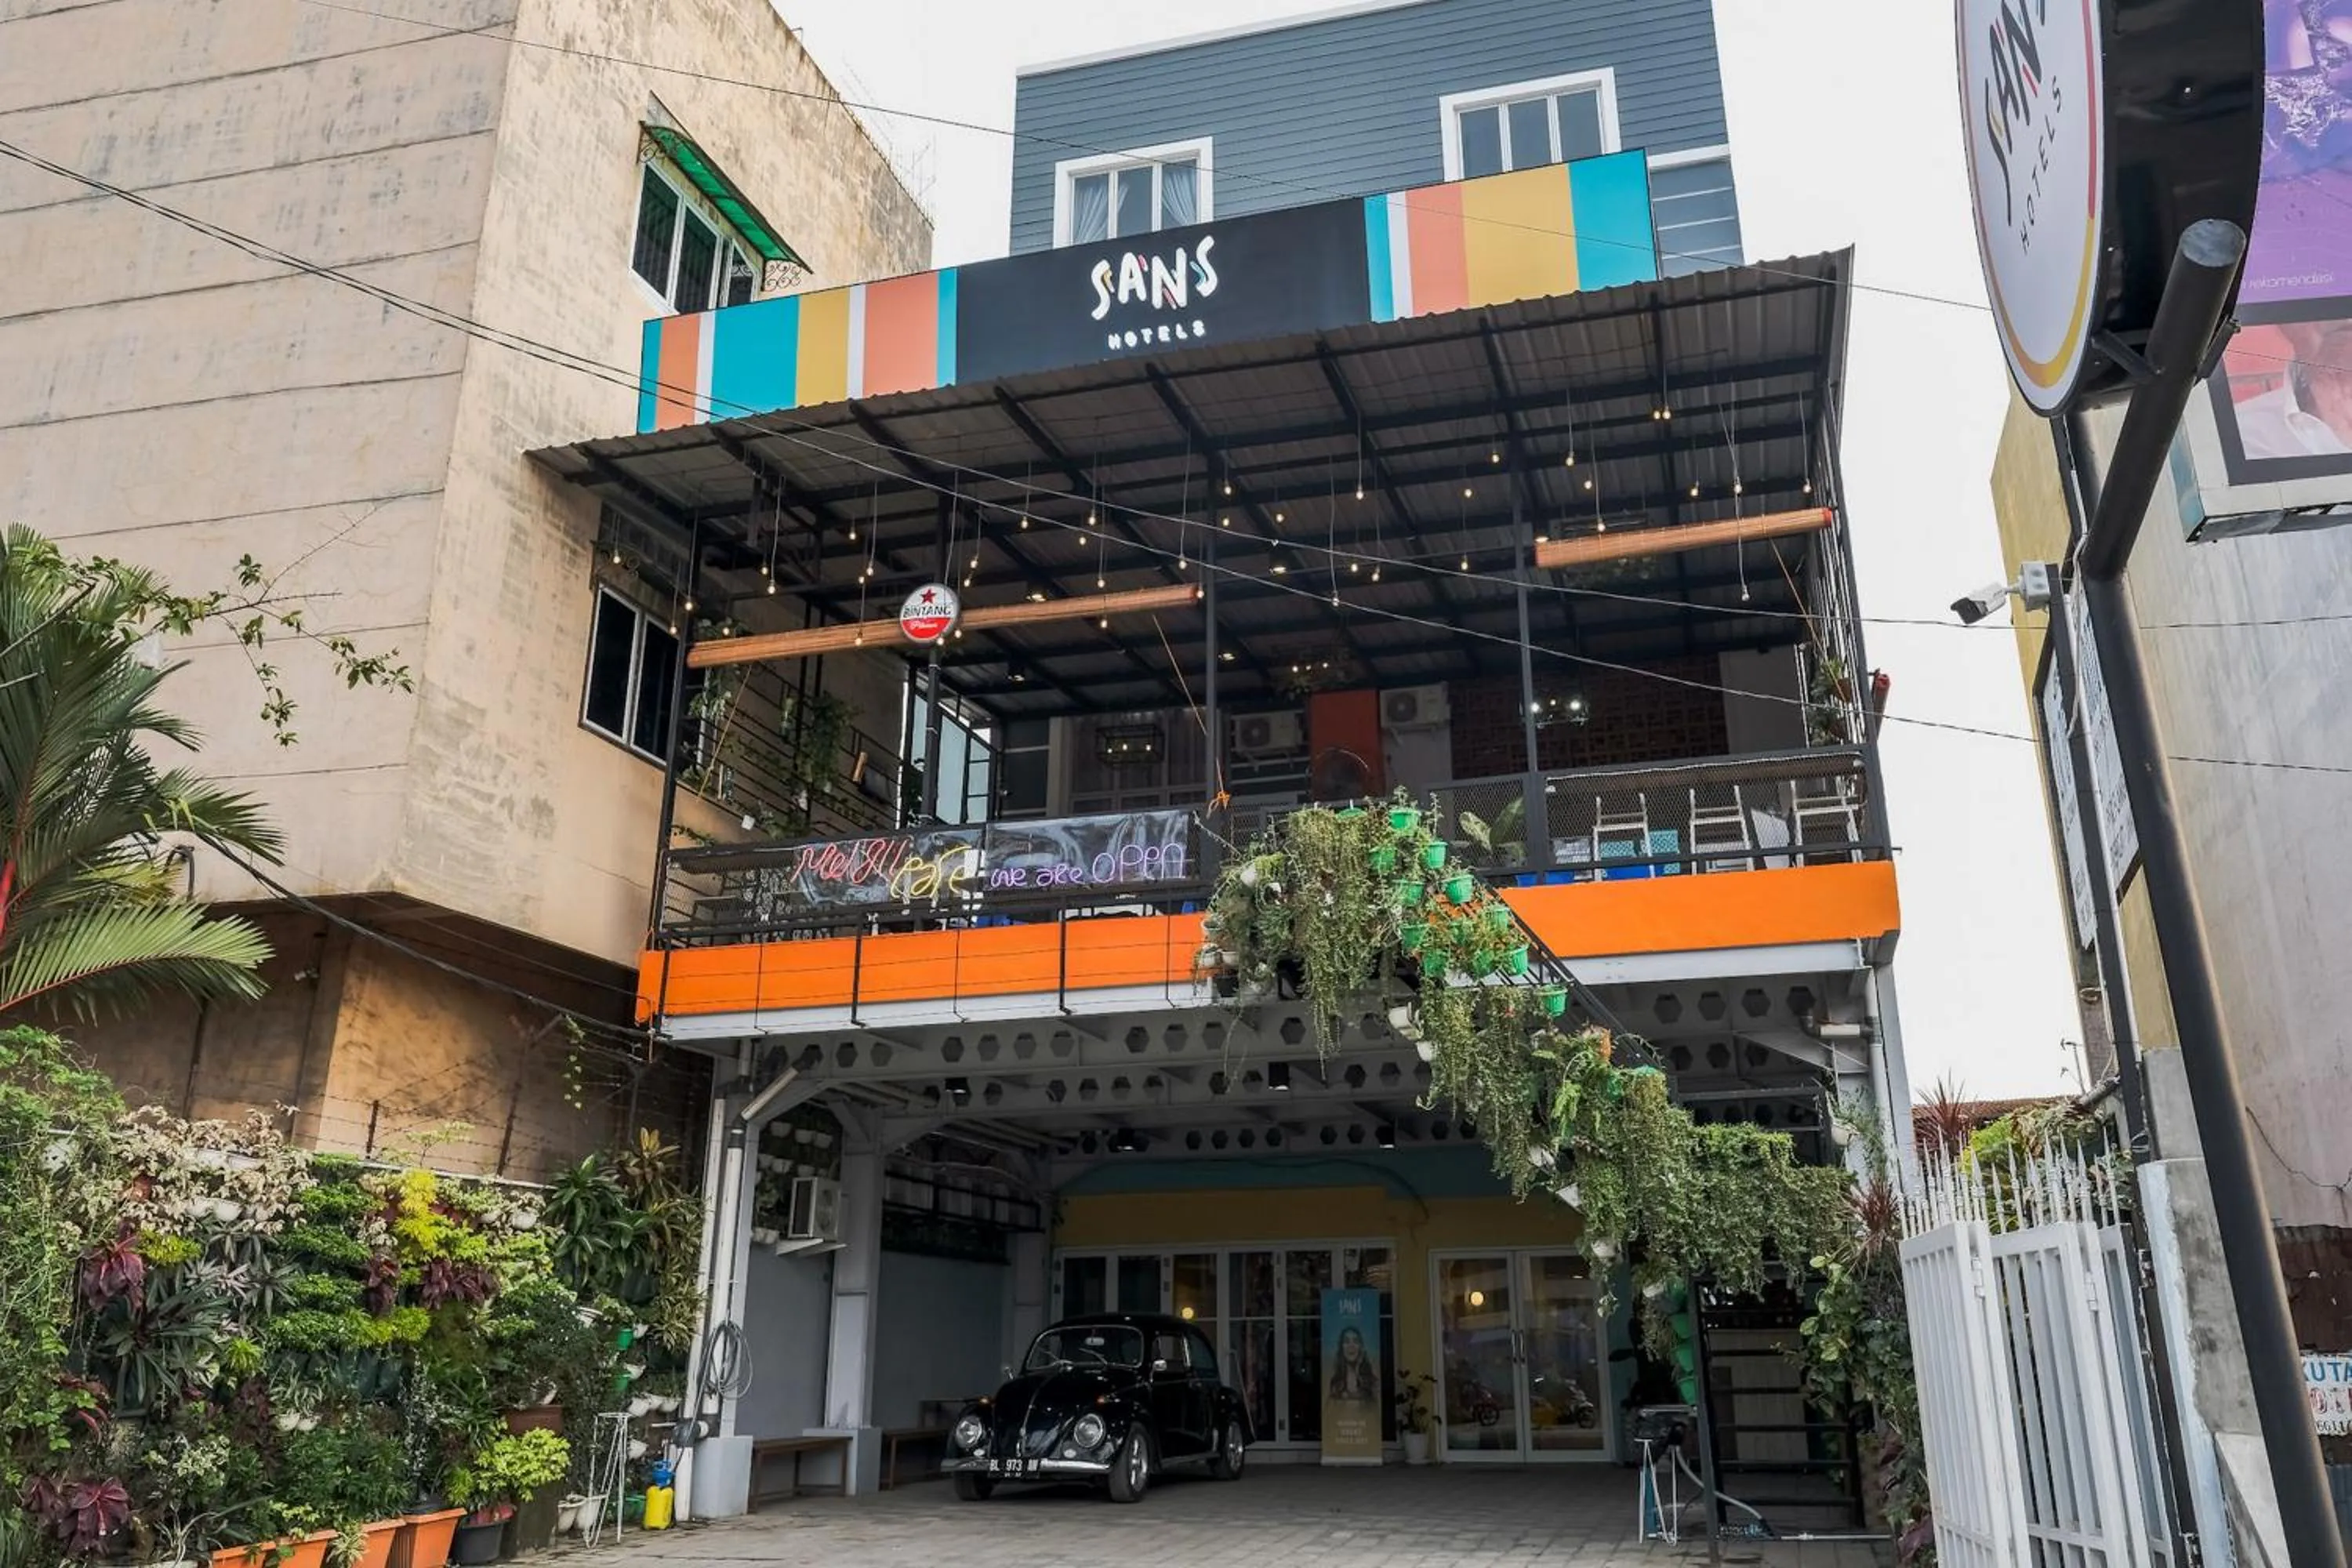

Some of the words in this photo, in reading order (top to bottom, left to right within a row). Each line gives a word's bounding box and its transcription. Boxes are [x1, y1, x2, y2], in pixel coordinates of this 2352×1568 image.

[2020, 75, 2062, 256] HOTELS
[1091, 235, 1218, 320] SANS
[1108, 320, 1206, 350] HOTELS
[902, 604, 952, 618] BINTANG
